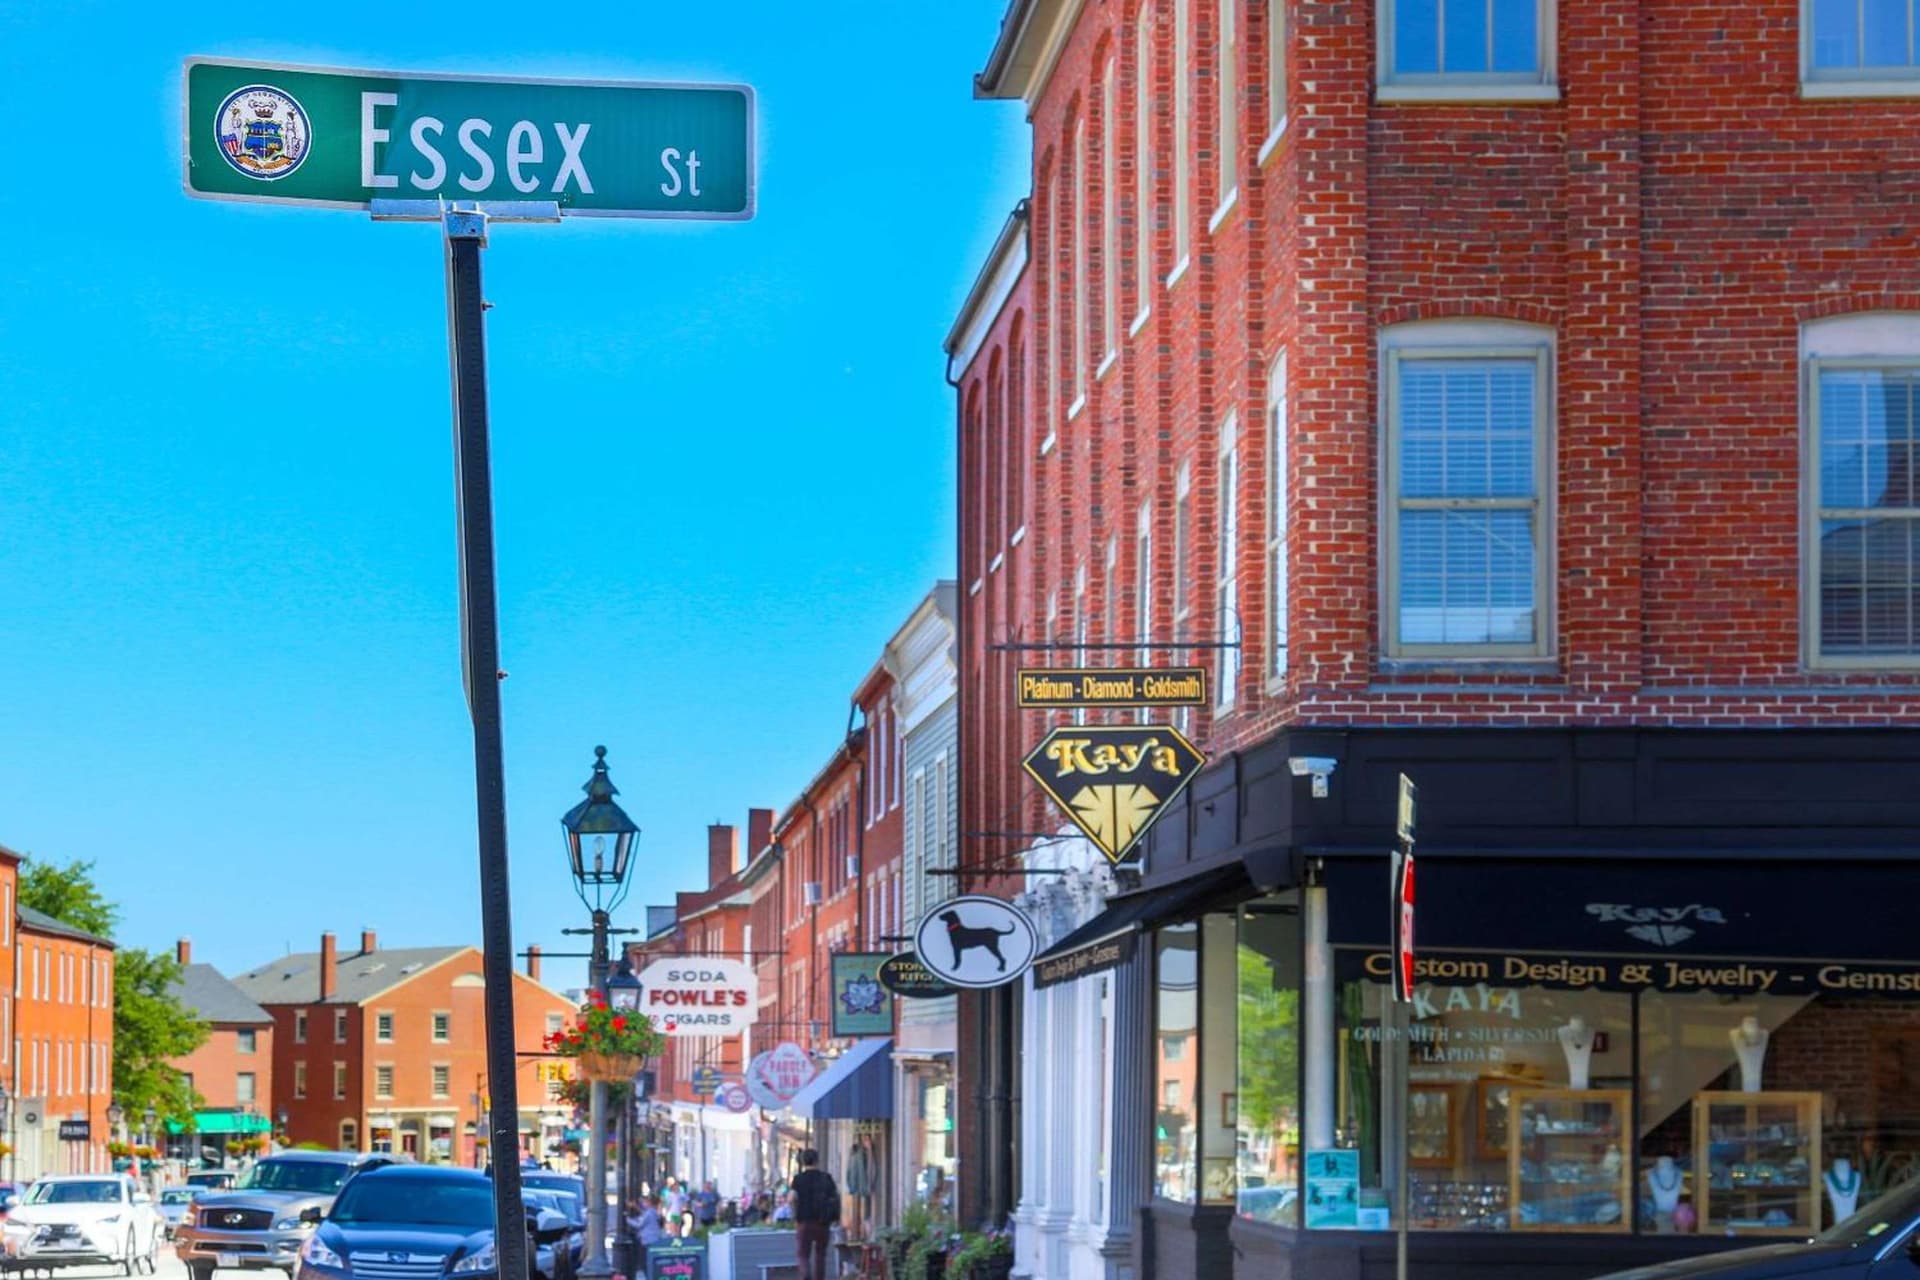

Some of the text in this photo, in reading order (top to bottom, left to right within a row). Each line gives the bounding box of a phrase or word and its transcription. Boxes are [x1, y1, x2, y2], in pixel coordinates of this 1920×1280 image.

[361, 91, 701, 197] Essex St
[1023, 677, 1073, 699] Platinum
[1083, 676, 1133, 698] Diamond
[1143, 676, 1200, 698] Goldsmith
[1047, 737, 1180, 777] Kaya
[1585, 903, 1727, 923] Kaya
[667, 970, 727, 982] SODA
[1364, 953, 1489, 978] Cstom
[1504, 957, 1606, 985] Design
[1620, 963, 1652, 983] &
[1665, 962, 1777, 988] Jewelry
[649, 988, 747, 1006] FOWLE'S
[1412, 983, 1521, 1019] KAYA
[663, 1013, 731, 1025] CIGARS
